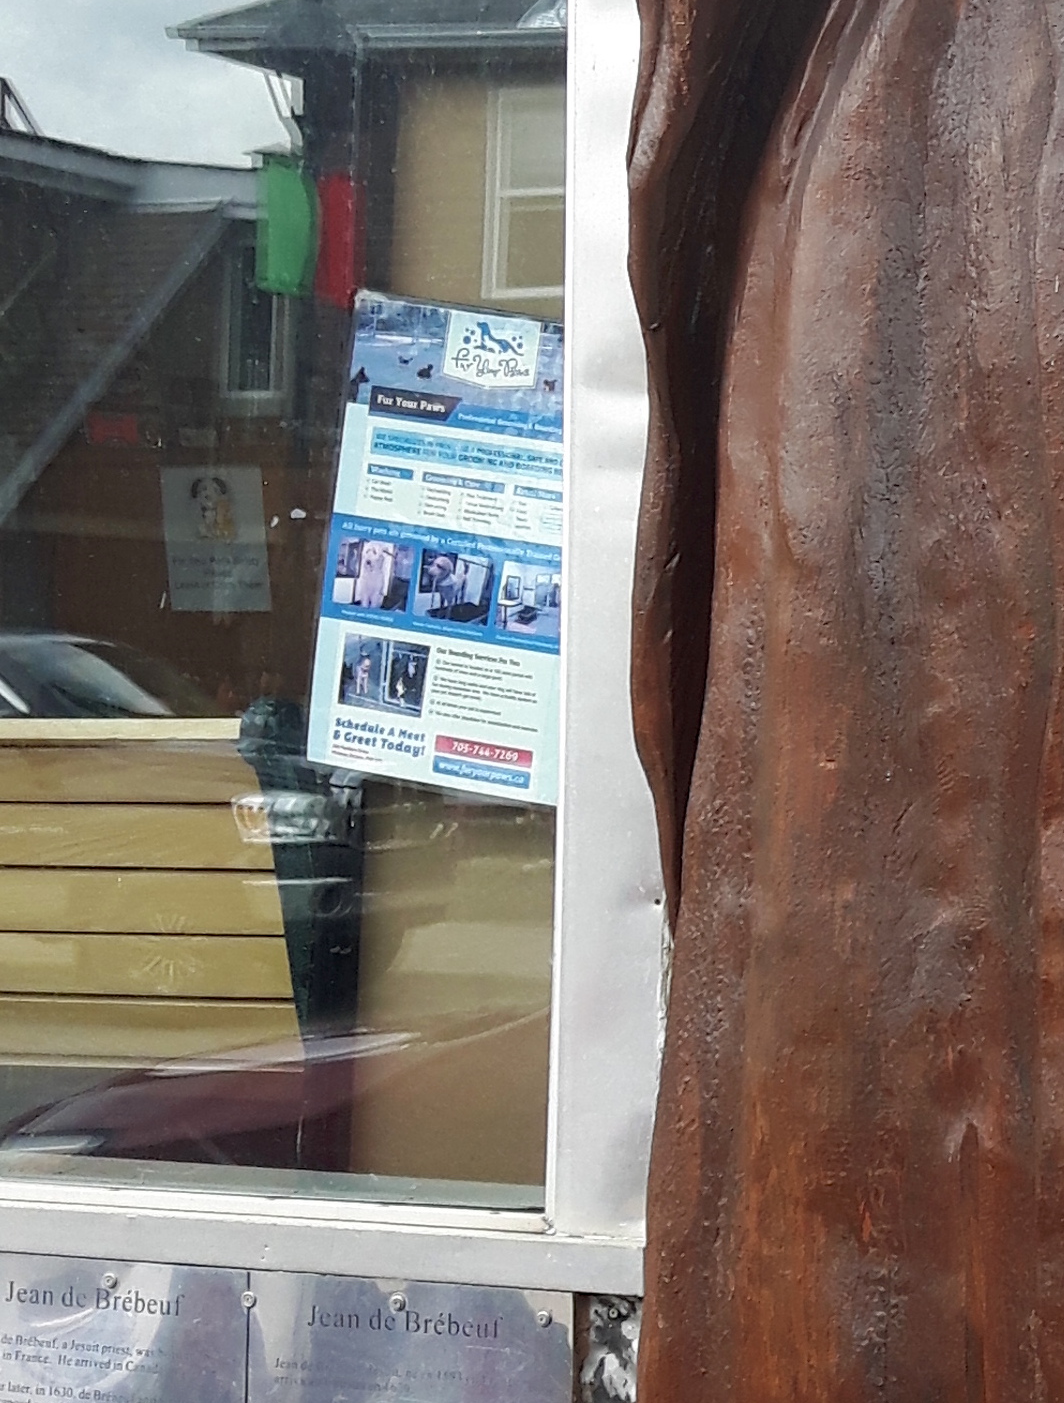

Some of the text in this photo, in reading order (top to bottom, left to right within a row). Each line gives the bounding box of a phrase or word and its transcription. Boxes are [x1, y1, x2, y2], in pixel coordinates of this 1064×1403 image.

[377, 394, 446, 413] Fur Your Paws
[333, 729, 341, 740] &
[344, 732, 378, 747] Greet
[381, 737, 426, 758] Today!
[335, 717, 426, 742] Schedule A Meet
[5, 1280, 186, 1317] Jean de Brébeuf
[307, 1304, 504, 1339] Jean de Brébeuf
